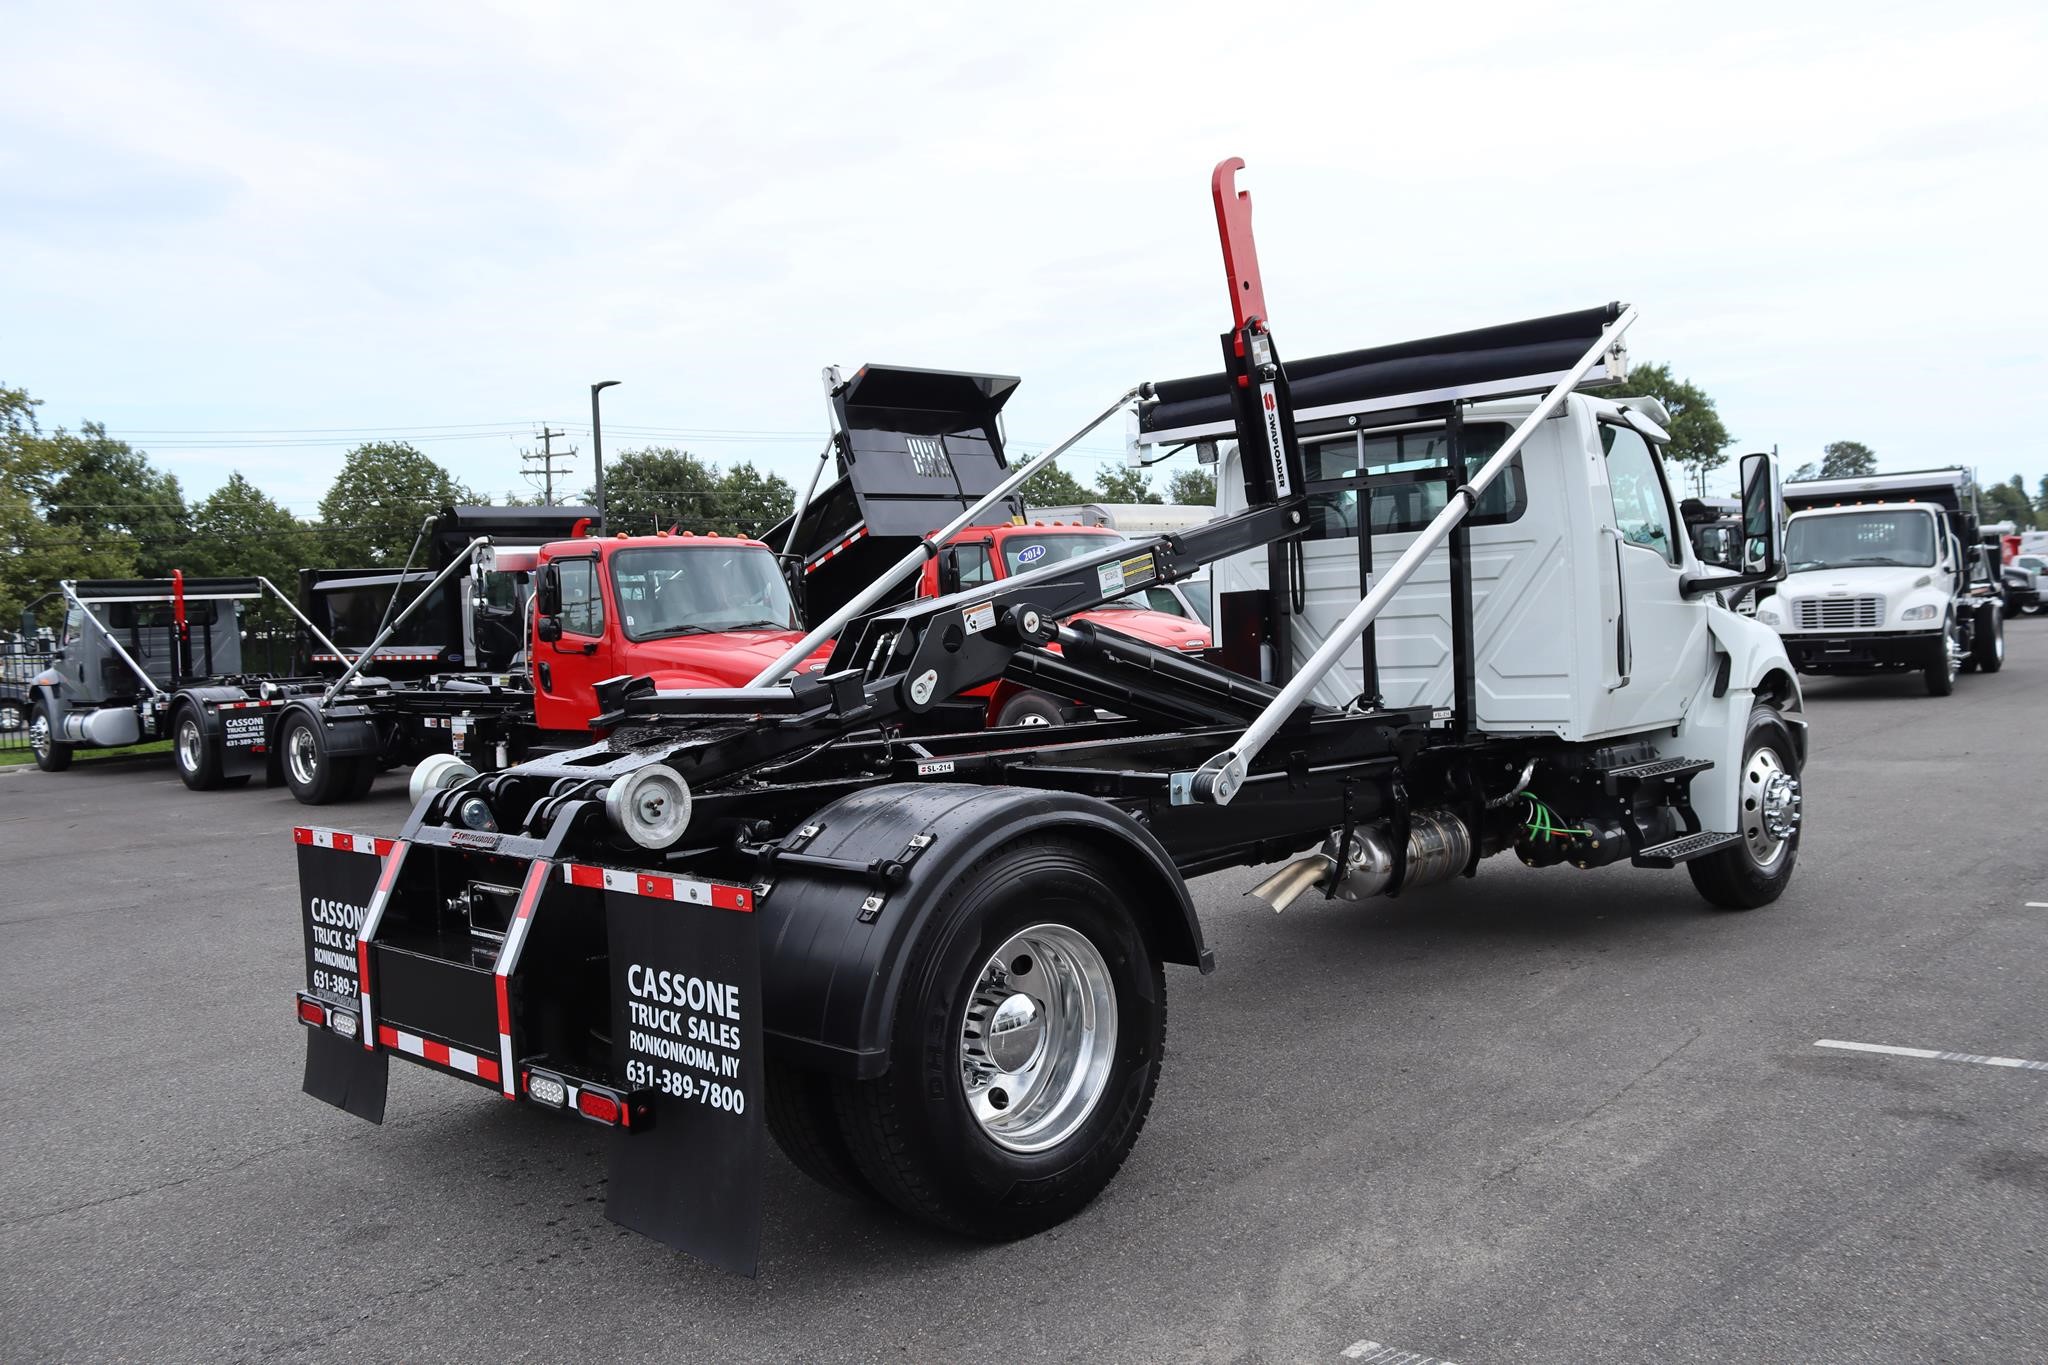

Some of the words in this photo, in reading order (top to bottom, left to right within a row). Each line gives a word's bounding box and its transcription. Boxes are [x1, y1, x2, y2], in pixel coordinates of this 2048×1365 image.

[1267, 413, 1286, 488] SWAPLOADER
[1023, 547, 1041, 561] 2014
[927, 764, 951, 772] SL-214
[311, 897, 367, 930] CASSON
[313, 926, 342, 948] TRUCK
[628, 964, 740, 1020] CASSONE
[629, 1001, 682, 1036] TRUCK
[688, 1016, 741, 1050] SALES
[630, 1030, 720, 1076] RONKONKOMA,
[722, 1055, 740, 1079] NY
[626, 1060, 745, 1115] 631-389-7800
